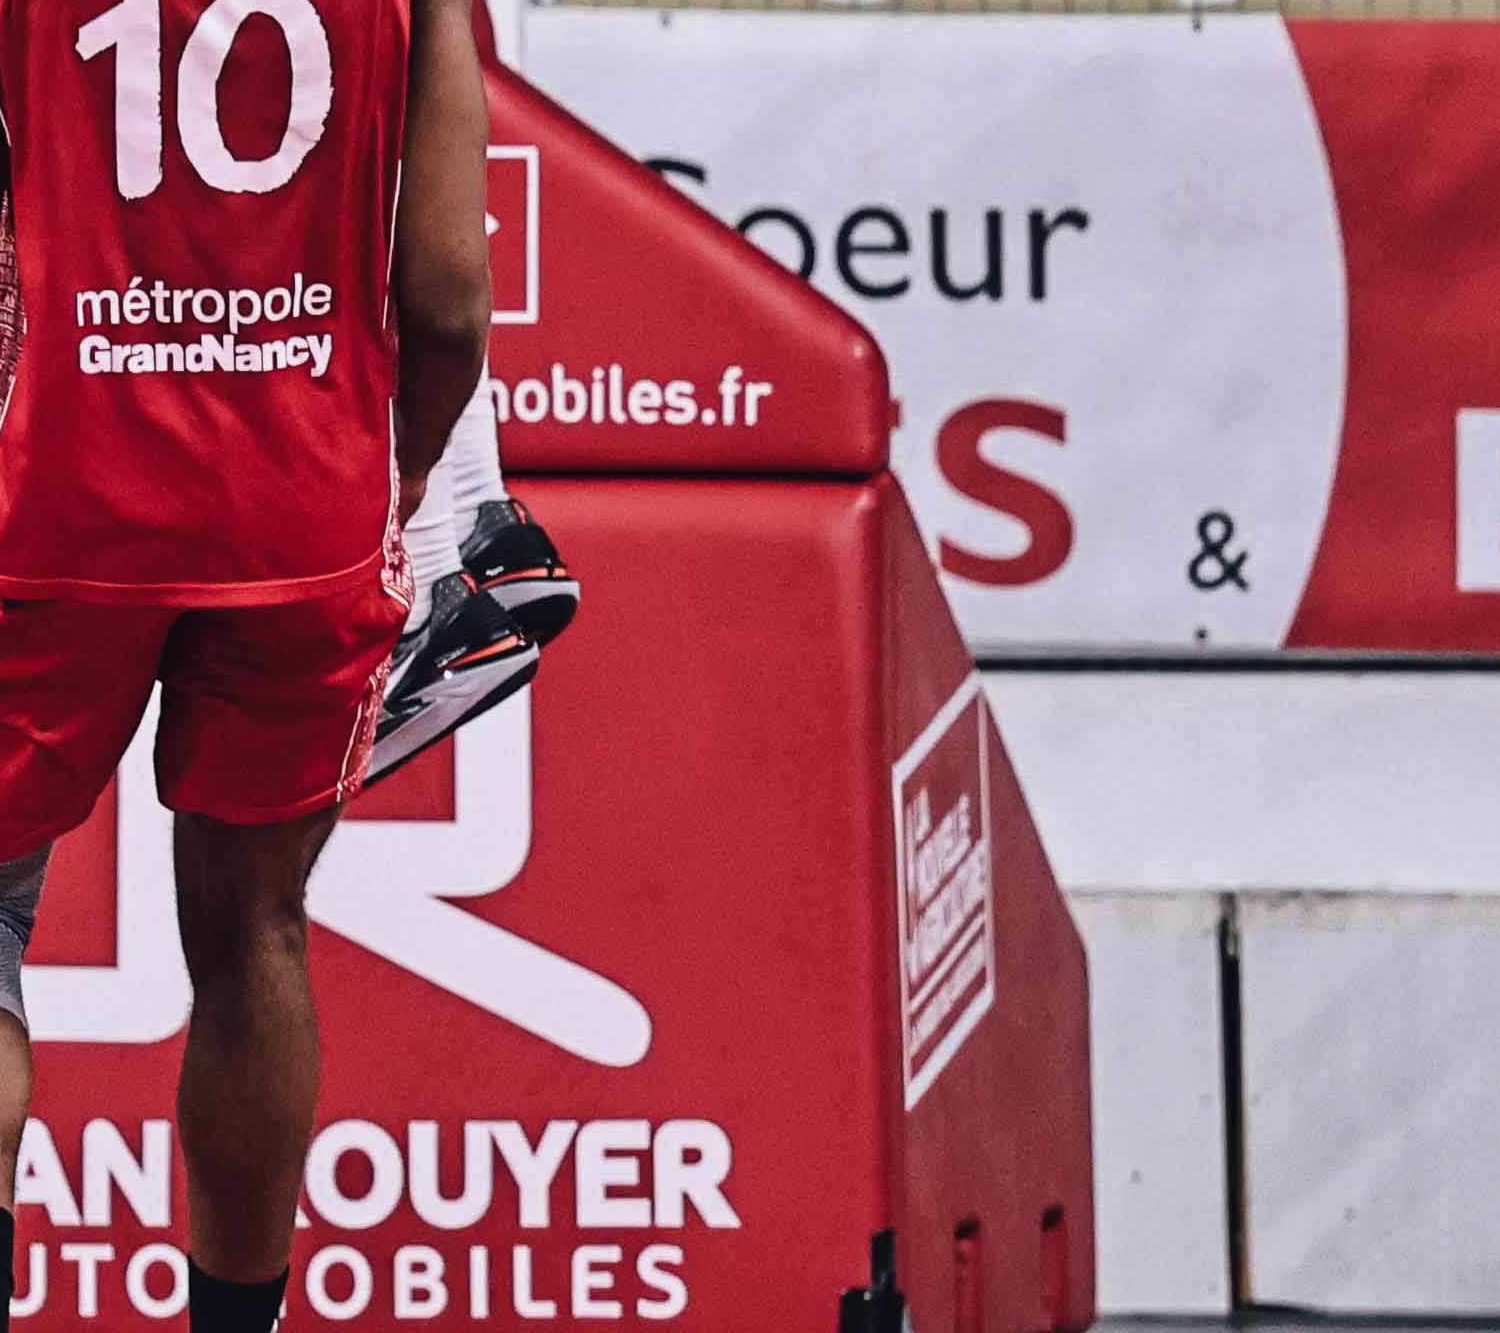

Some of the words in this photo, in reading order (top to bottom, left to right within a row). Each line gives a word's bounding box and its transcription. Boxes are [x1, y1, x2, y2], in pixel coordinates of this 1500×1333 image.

[76, 272, 333, 343] métropole
[1188, 510, 1249, 592] &
[295, 1118, 742, 1231] OUYER
